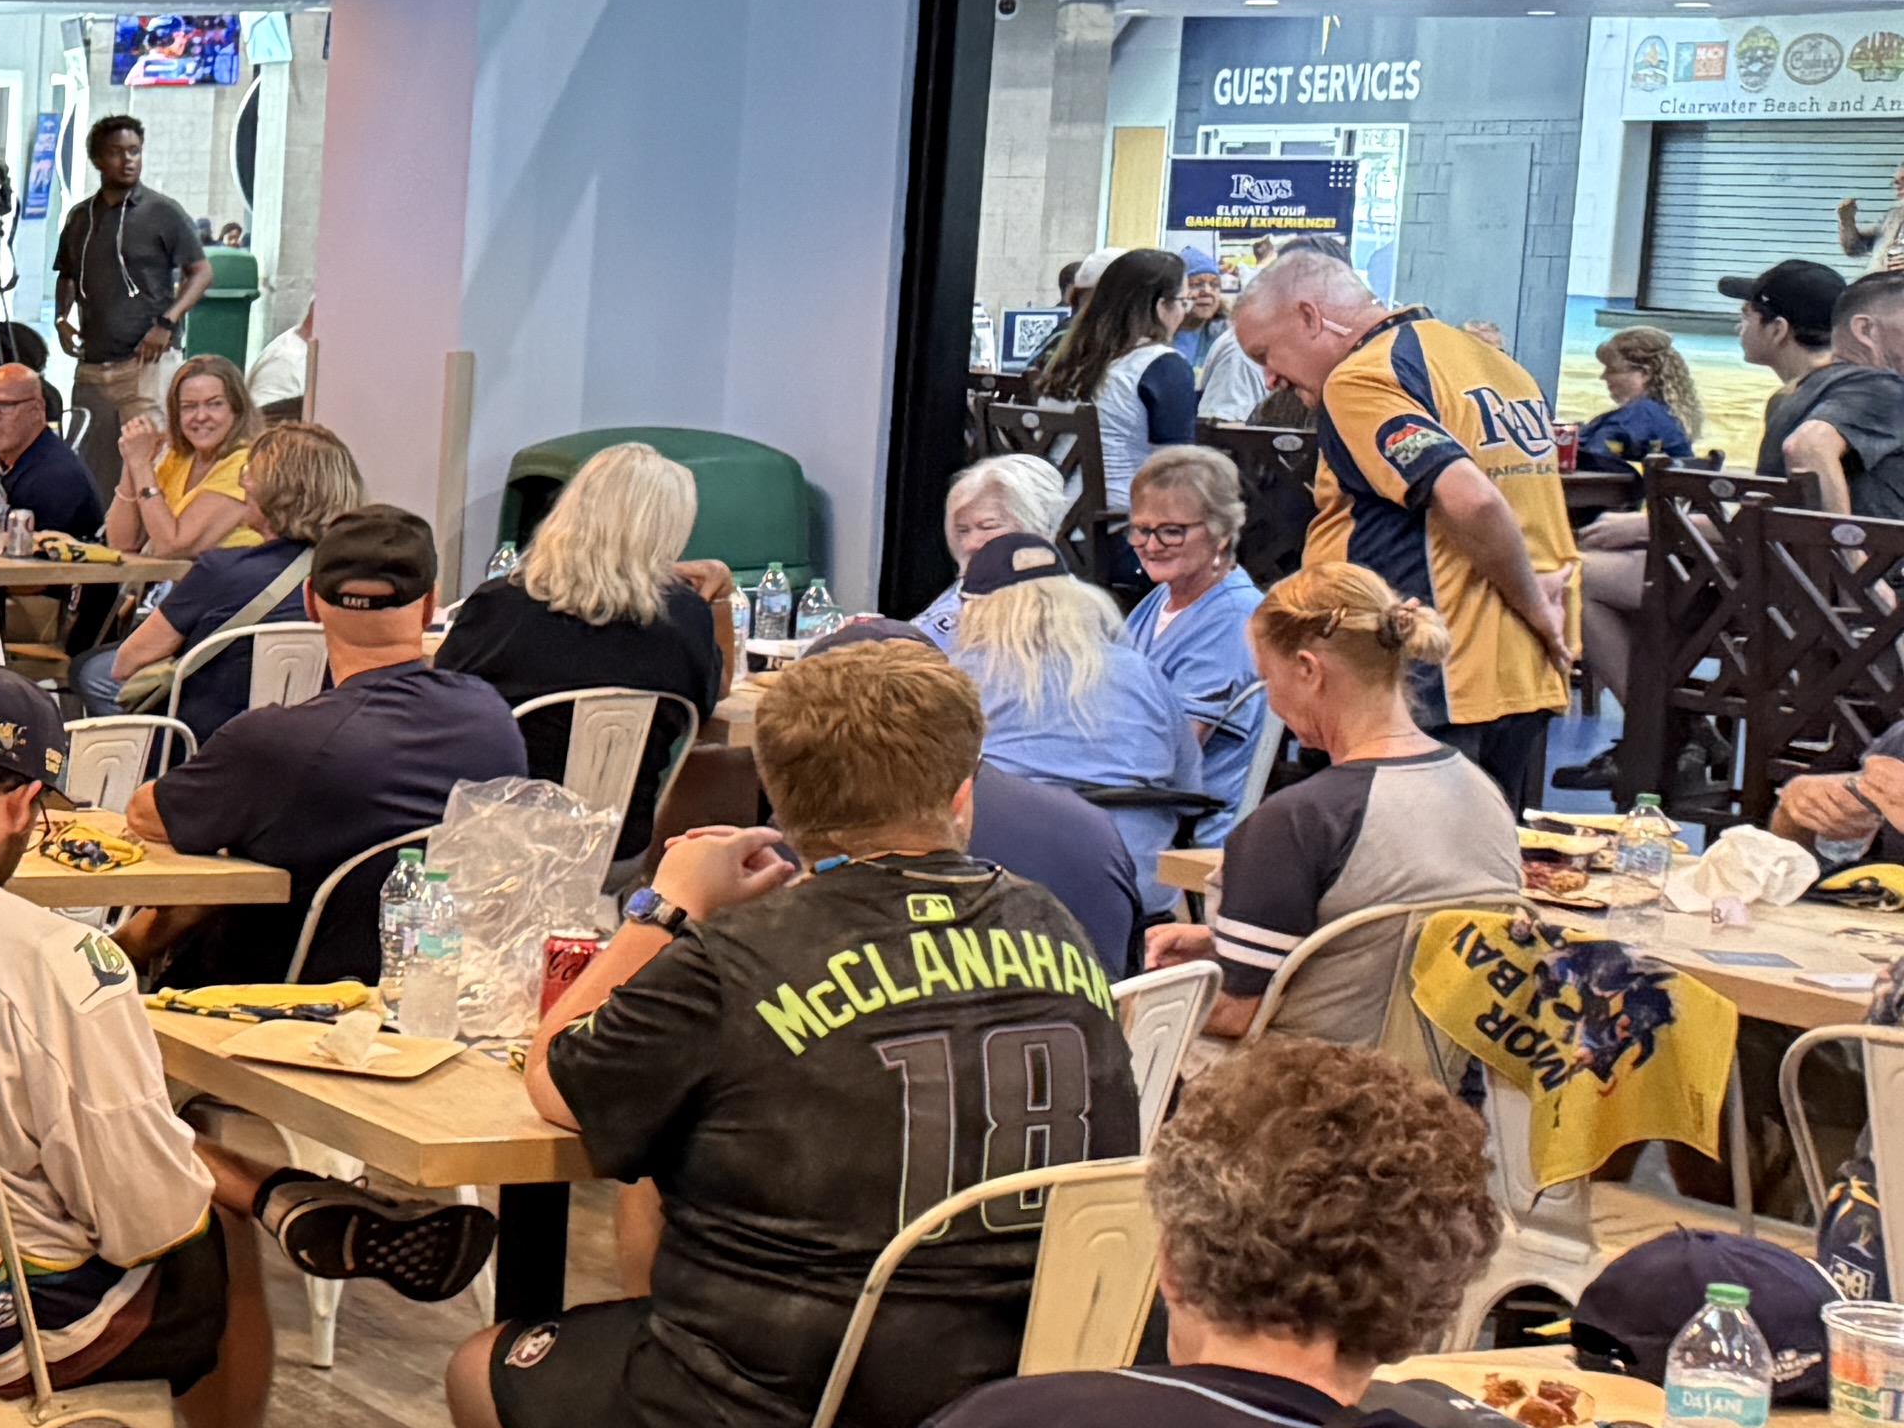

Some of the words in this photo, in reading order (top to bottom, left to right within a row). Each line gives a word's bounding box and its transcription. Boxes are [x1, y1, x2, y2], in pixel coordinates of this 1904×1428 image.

[1213, 67, 1294, 105] GUEST
[1297, 60, 1421, 103] SERVICES
[1659, 97, 1758, 115] Clearwater
[1763, 97, 1821, 114] Beach
[1827, 95, 1865, 113] and
[1185, 217, 1248, 228] GAMEDAY
[1216, 205, 1269, 217] ELEVATE
[1272, 205, 1306, 216] YOUR
[1462, 384, 1558, 460] RAY
[342, 596, 370, 609] RAYS
[755, 927, 1116, 1057] McCLANAHAN
[872, 1020, 1093, 1246] 18
[1682, 1390, 1745, 1416] DASANI
